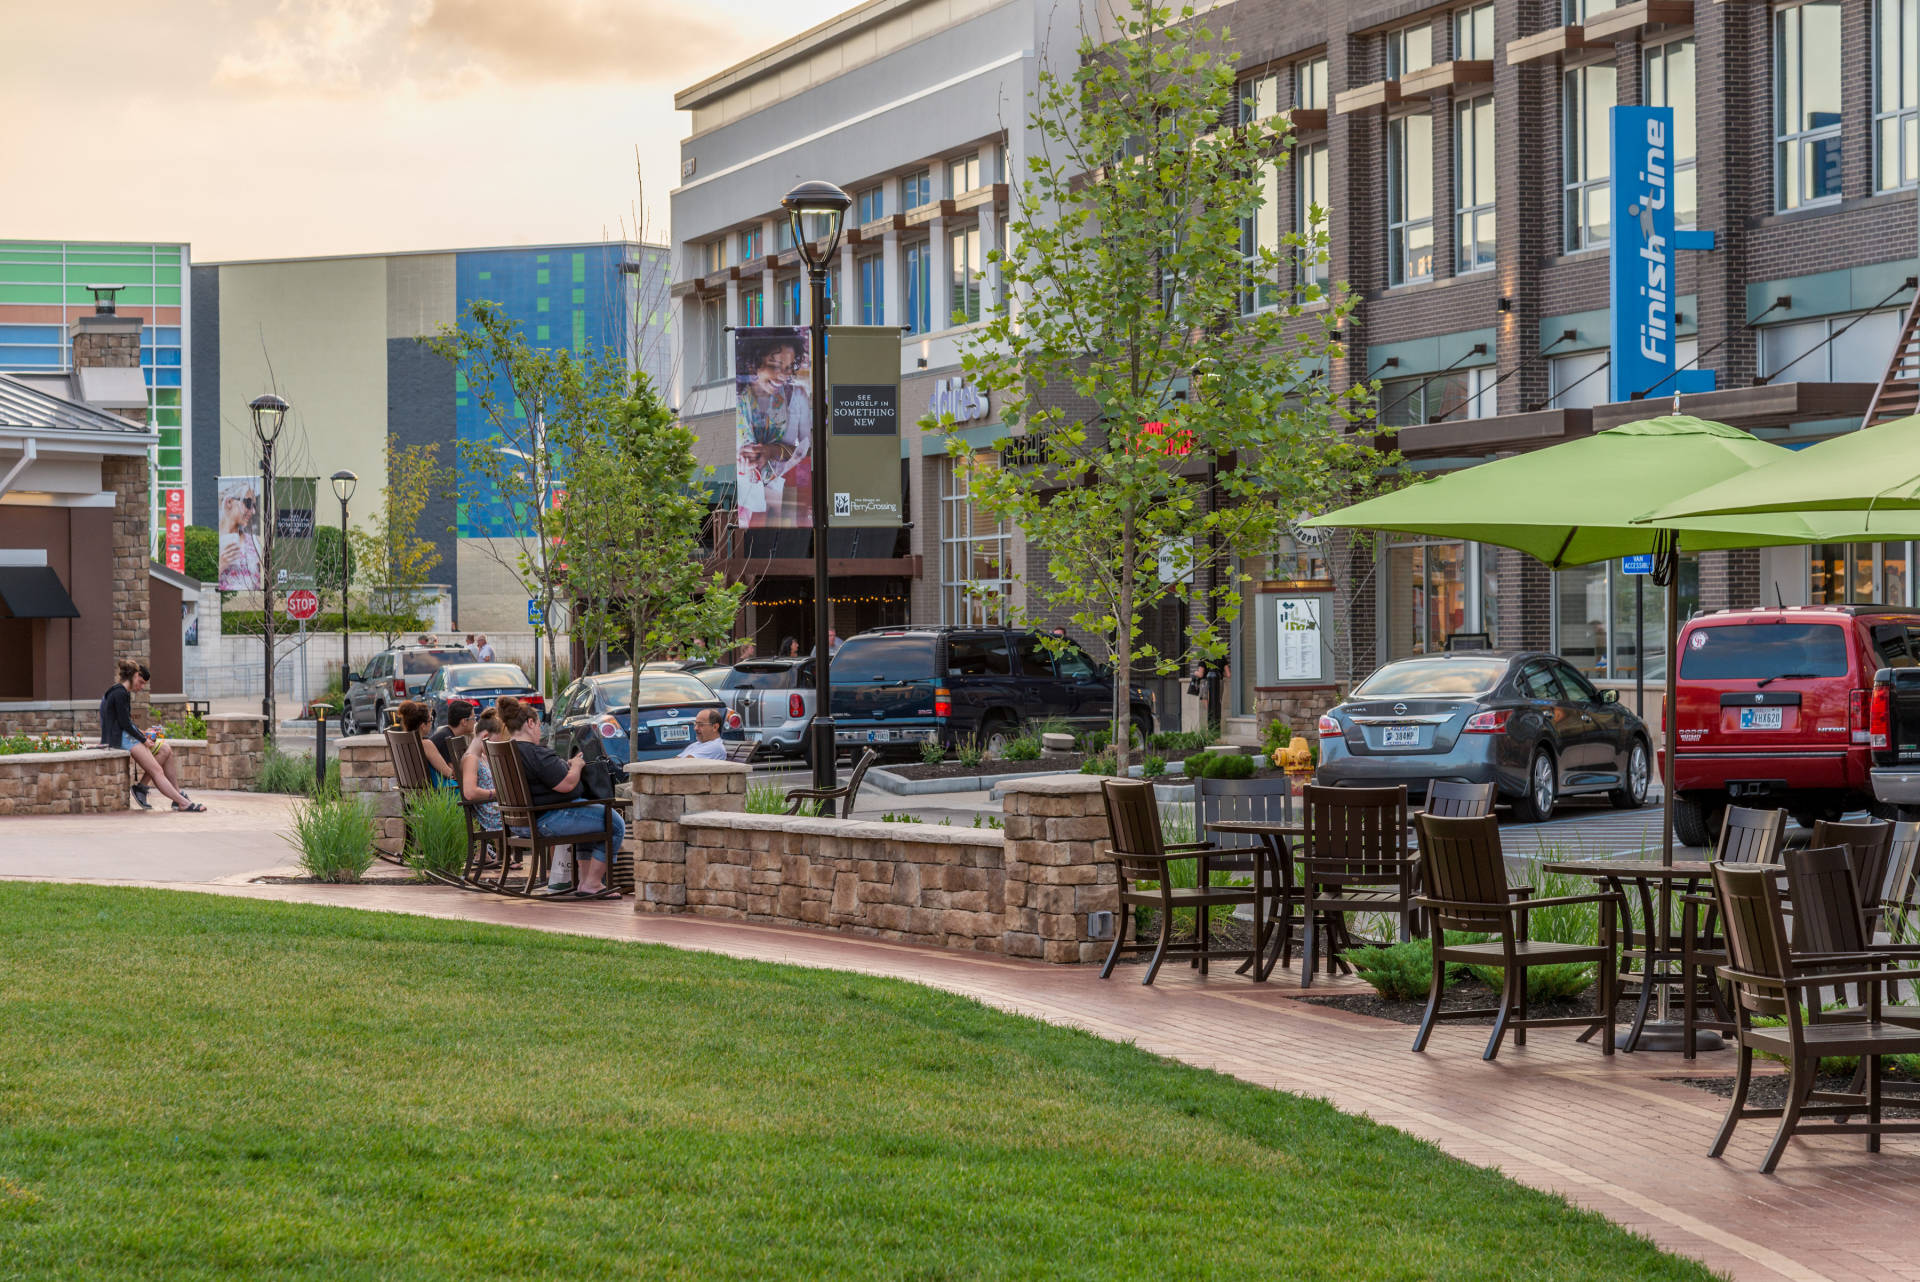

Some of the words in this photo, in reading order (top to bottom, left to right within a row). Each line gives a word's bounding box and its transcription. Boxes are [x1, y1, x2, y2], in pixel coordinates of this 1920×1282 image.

[833, 408, 895, 417] SOMETHING
[853, 418, 875, 426] NEW
[289, 599, 316, 611] STOP
[1753, 713, 1781, 725] VHX620
